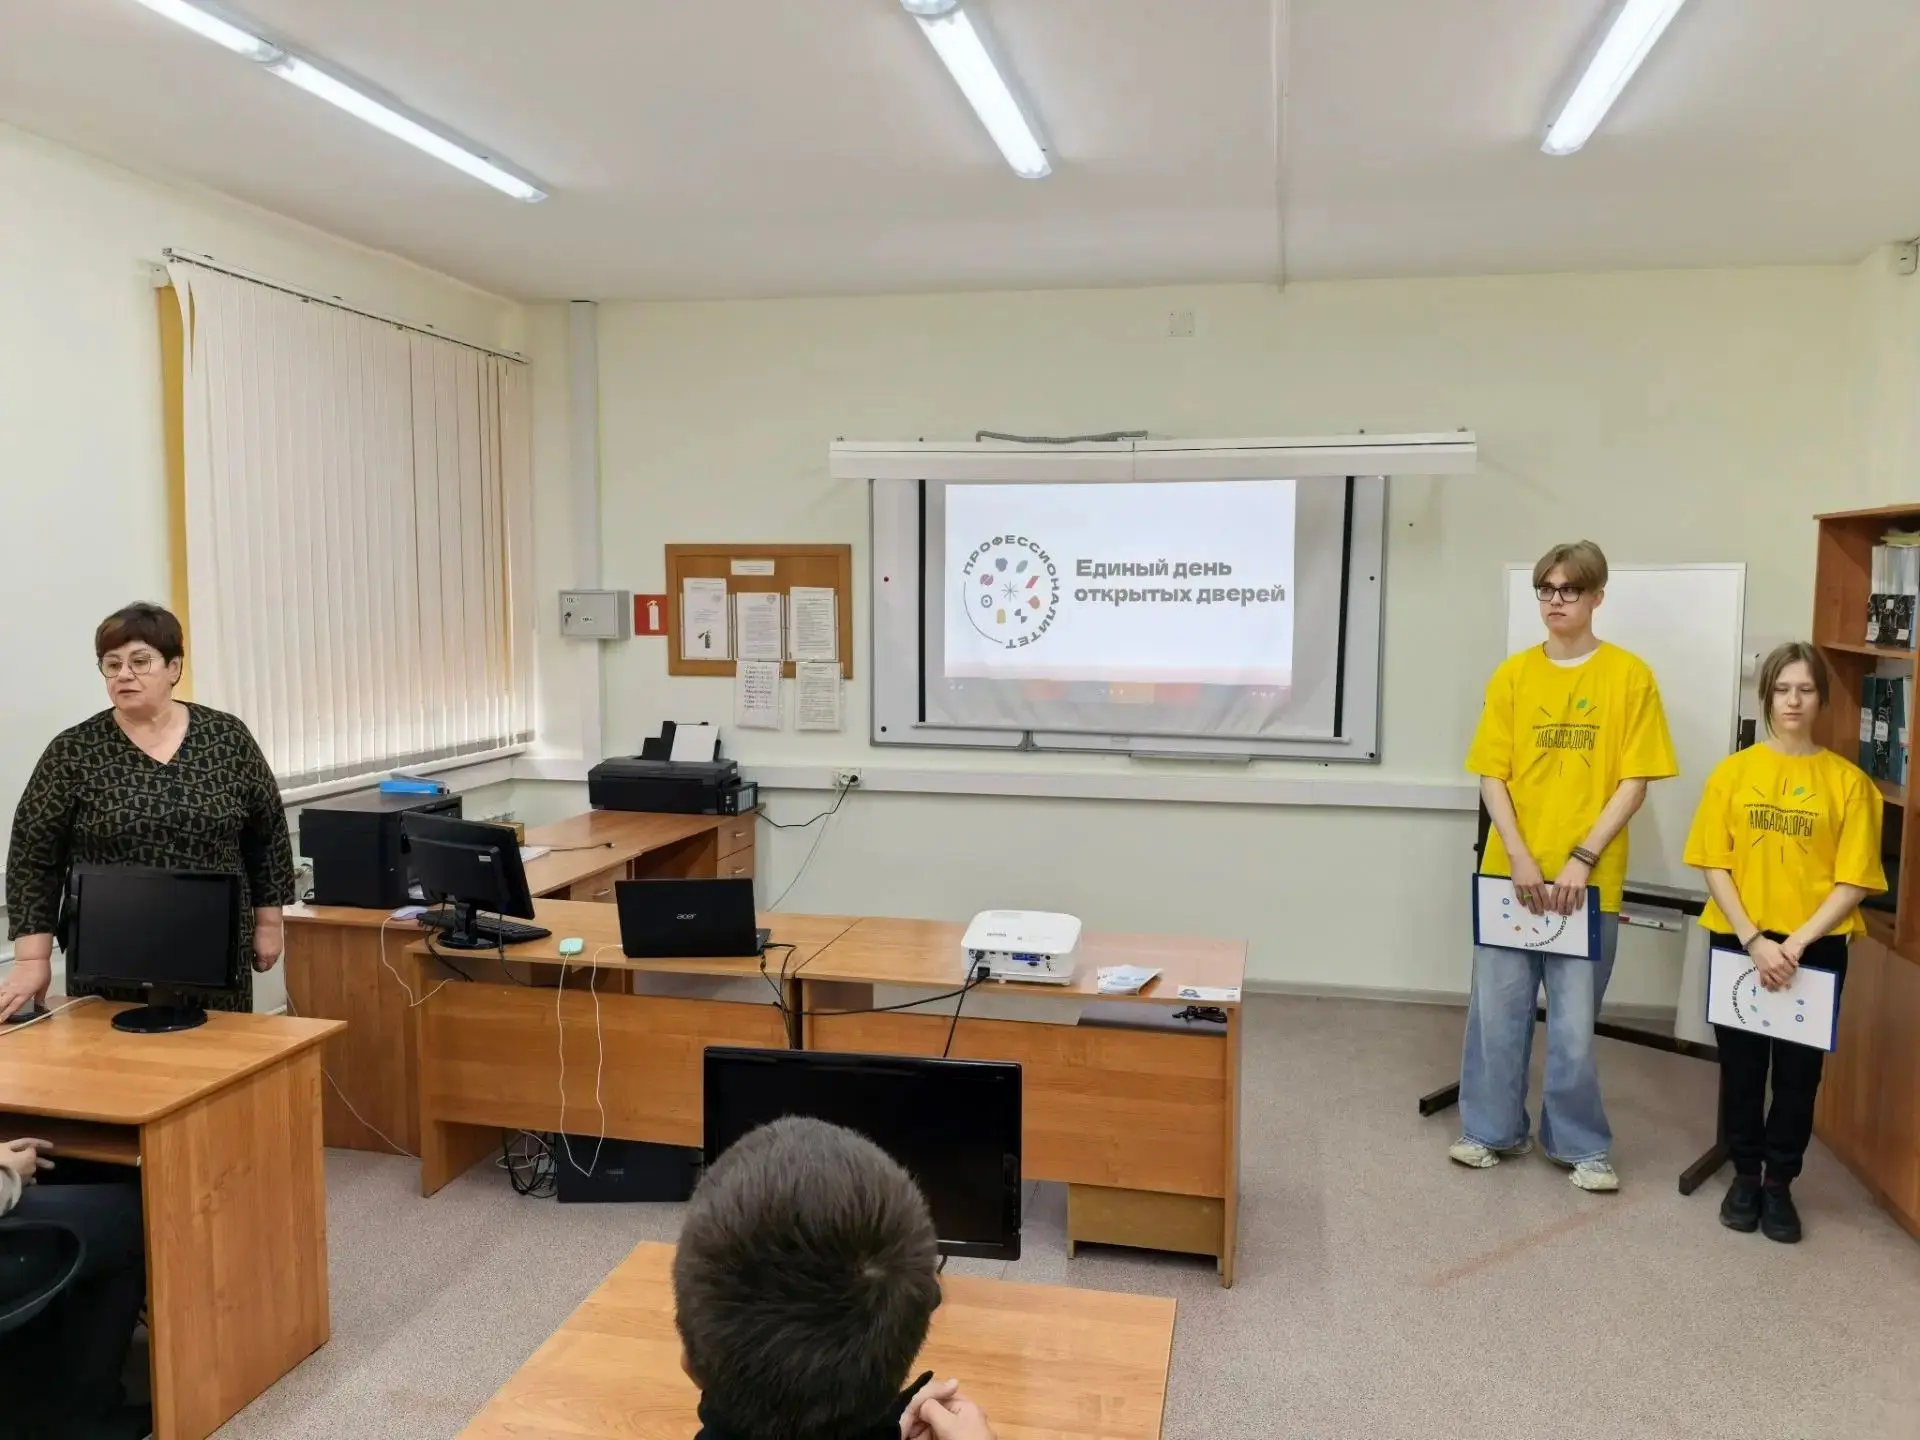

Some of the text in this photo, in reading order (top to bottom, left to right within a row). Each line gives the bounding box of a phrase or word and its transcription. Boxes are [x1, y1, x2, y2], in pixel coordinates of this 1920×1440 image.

[1076, 558, 1233, 580] Единый день
[963, 535, 1060, 649] ПРОФЕССИОНАЛИТЕТ
[1074, 585, 1286, 607] открытых дверей
[1535, 729, 1596, 750] АМБАССАДОРЫ
[1749, 809, 1813, 837] АМБАССАДОРЫ
[1524, 915, 1568, 948] ССИОНАЛИТЕТ
